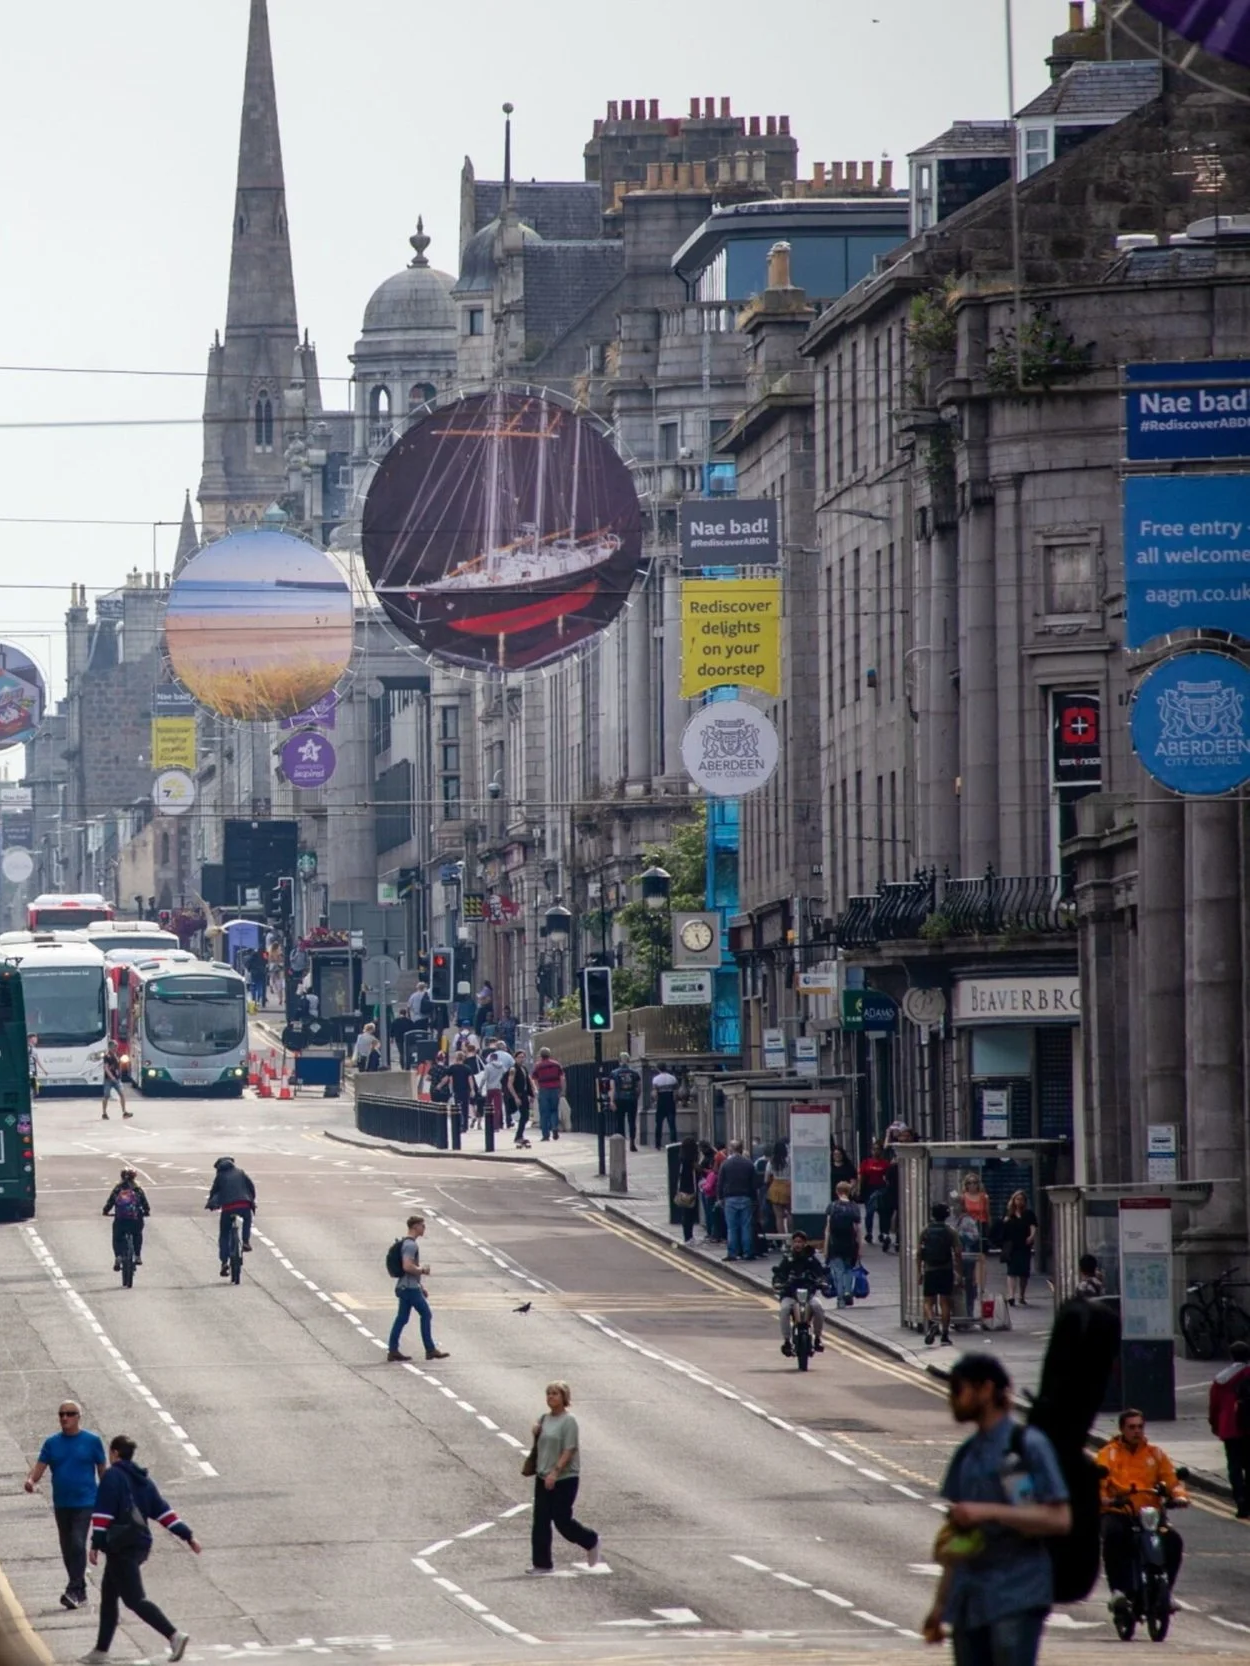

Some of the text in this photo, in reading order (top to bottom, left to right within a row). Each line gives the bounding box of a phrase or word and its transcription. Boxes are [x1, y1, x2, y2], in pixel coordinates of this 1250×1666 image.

[1139, 389, 1250, 414] Nae bad
[690, 518, 769, 536] Nae bad!
[1140, 520, 1242, 540] Free entry
[691, 537, 769, 548] #RediscoverABDN
[1137, 546, 1250, 564] all welcome
[1146, 583, 1250, 607] aagm.co.uk
[690, 601, 771, 614] Rediscover
[702, 621, 761, 638] delights
[703, 643, 760, 659] on your
[698, 662, 765, 678] doorstep
[1155, 739, 1250, 757] ABERDEEN
[698, 760, 765, 772] ABERDEEN
[1165, 756, 1242, 766] CITY COUNCIL
